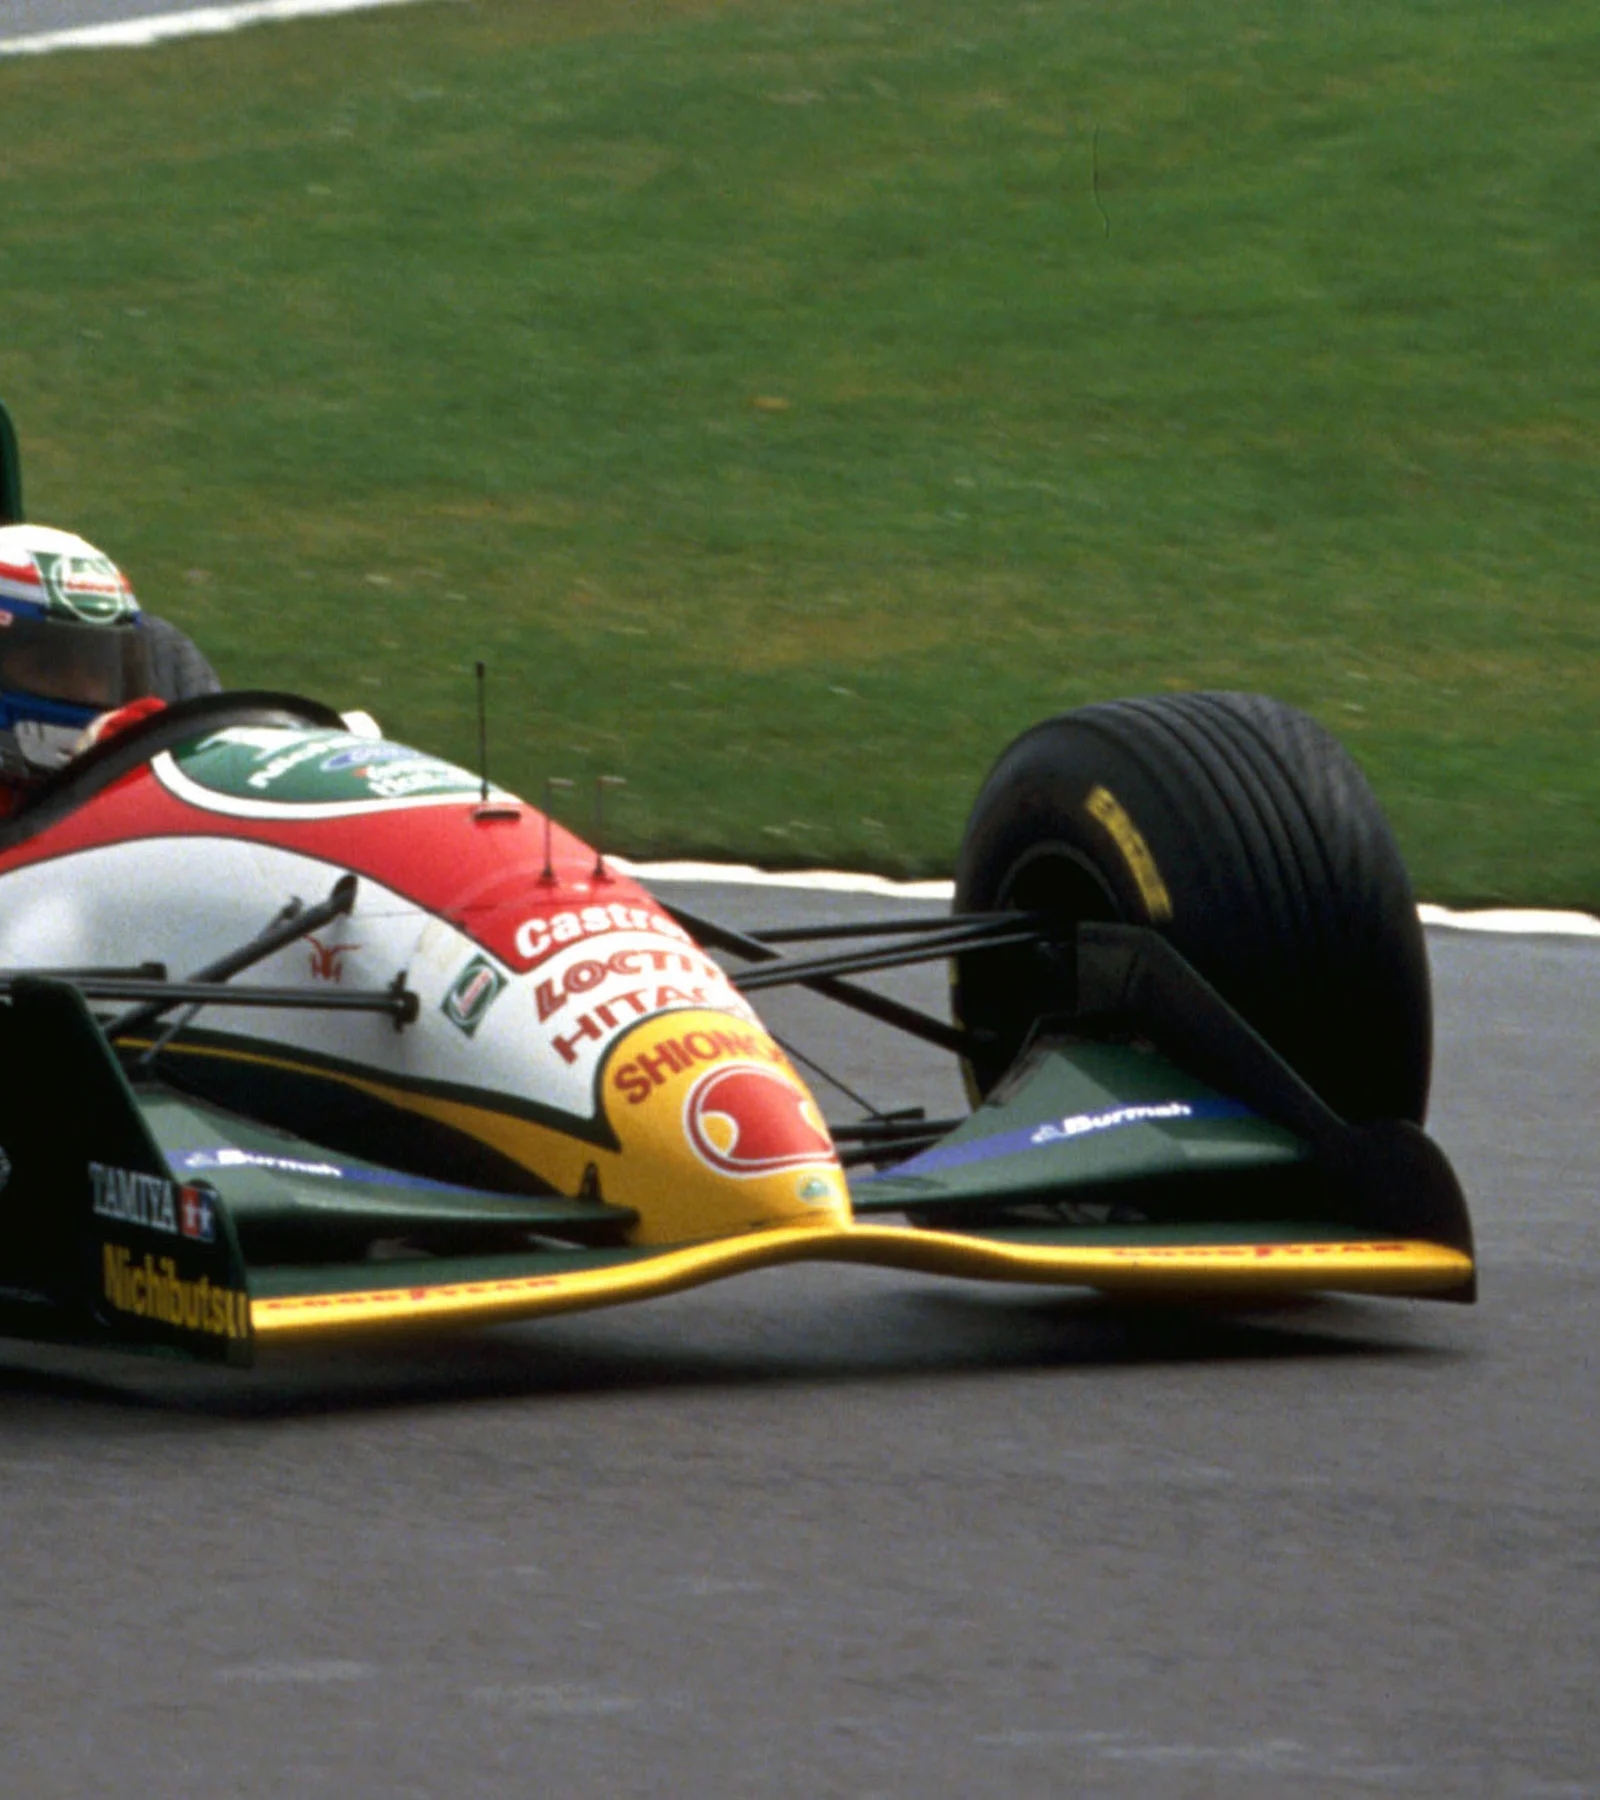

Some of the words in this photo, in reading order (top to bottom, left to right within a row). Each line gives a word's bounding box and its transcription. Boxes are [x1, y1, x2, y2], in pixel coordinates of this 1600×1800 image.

[613, 1030, 784, 1104] SHION
[1062, 1103, 1192, 1135] Burmah
[89, 1161, 178, 1235] TAMIYA
[103, 1242, 248, 1338] Nichibutsu
